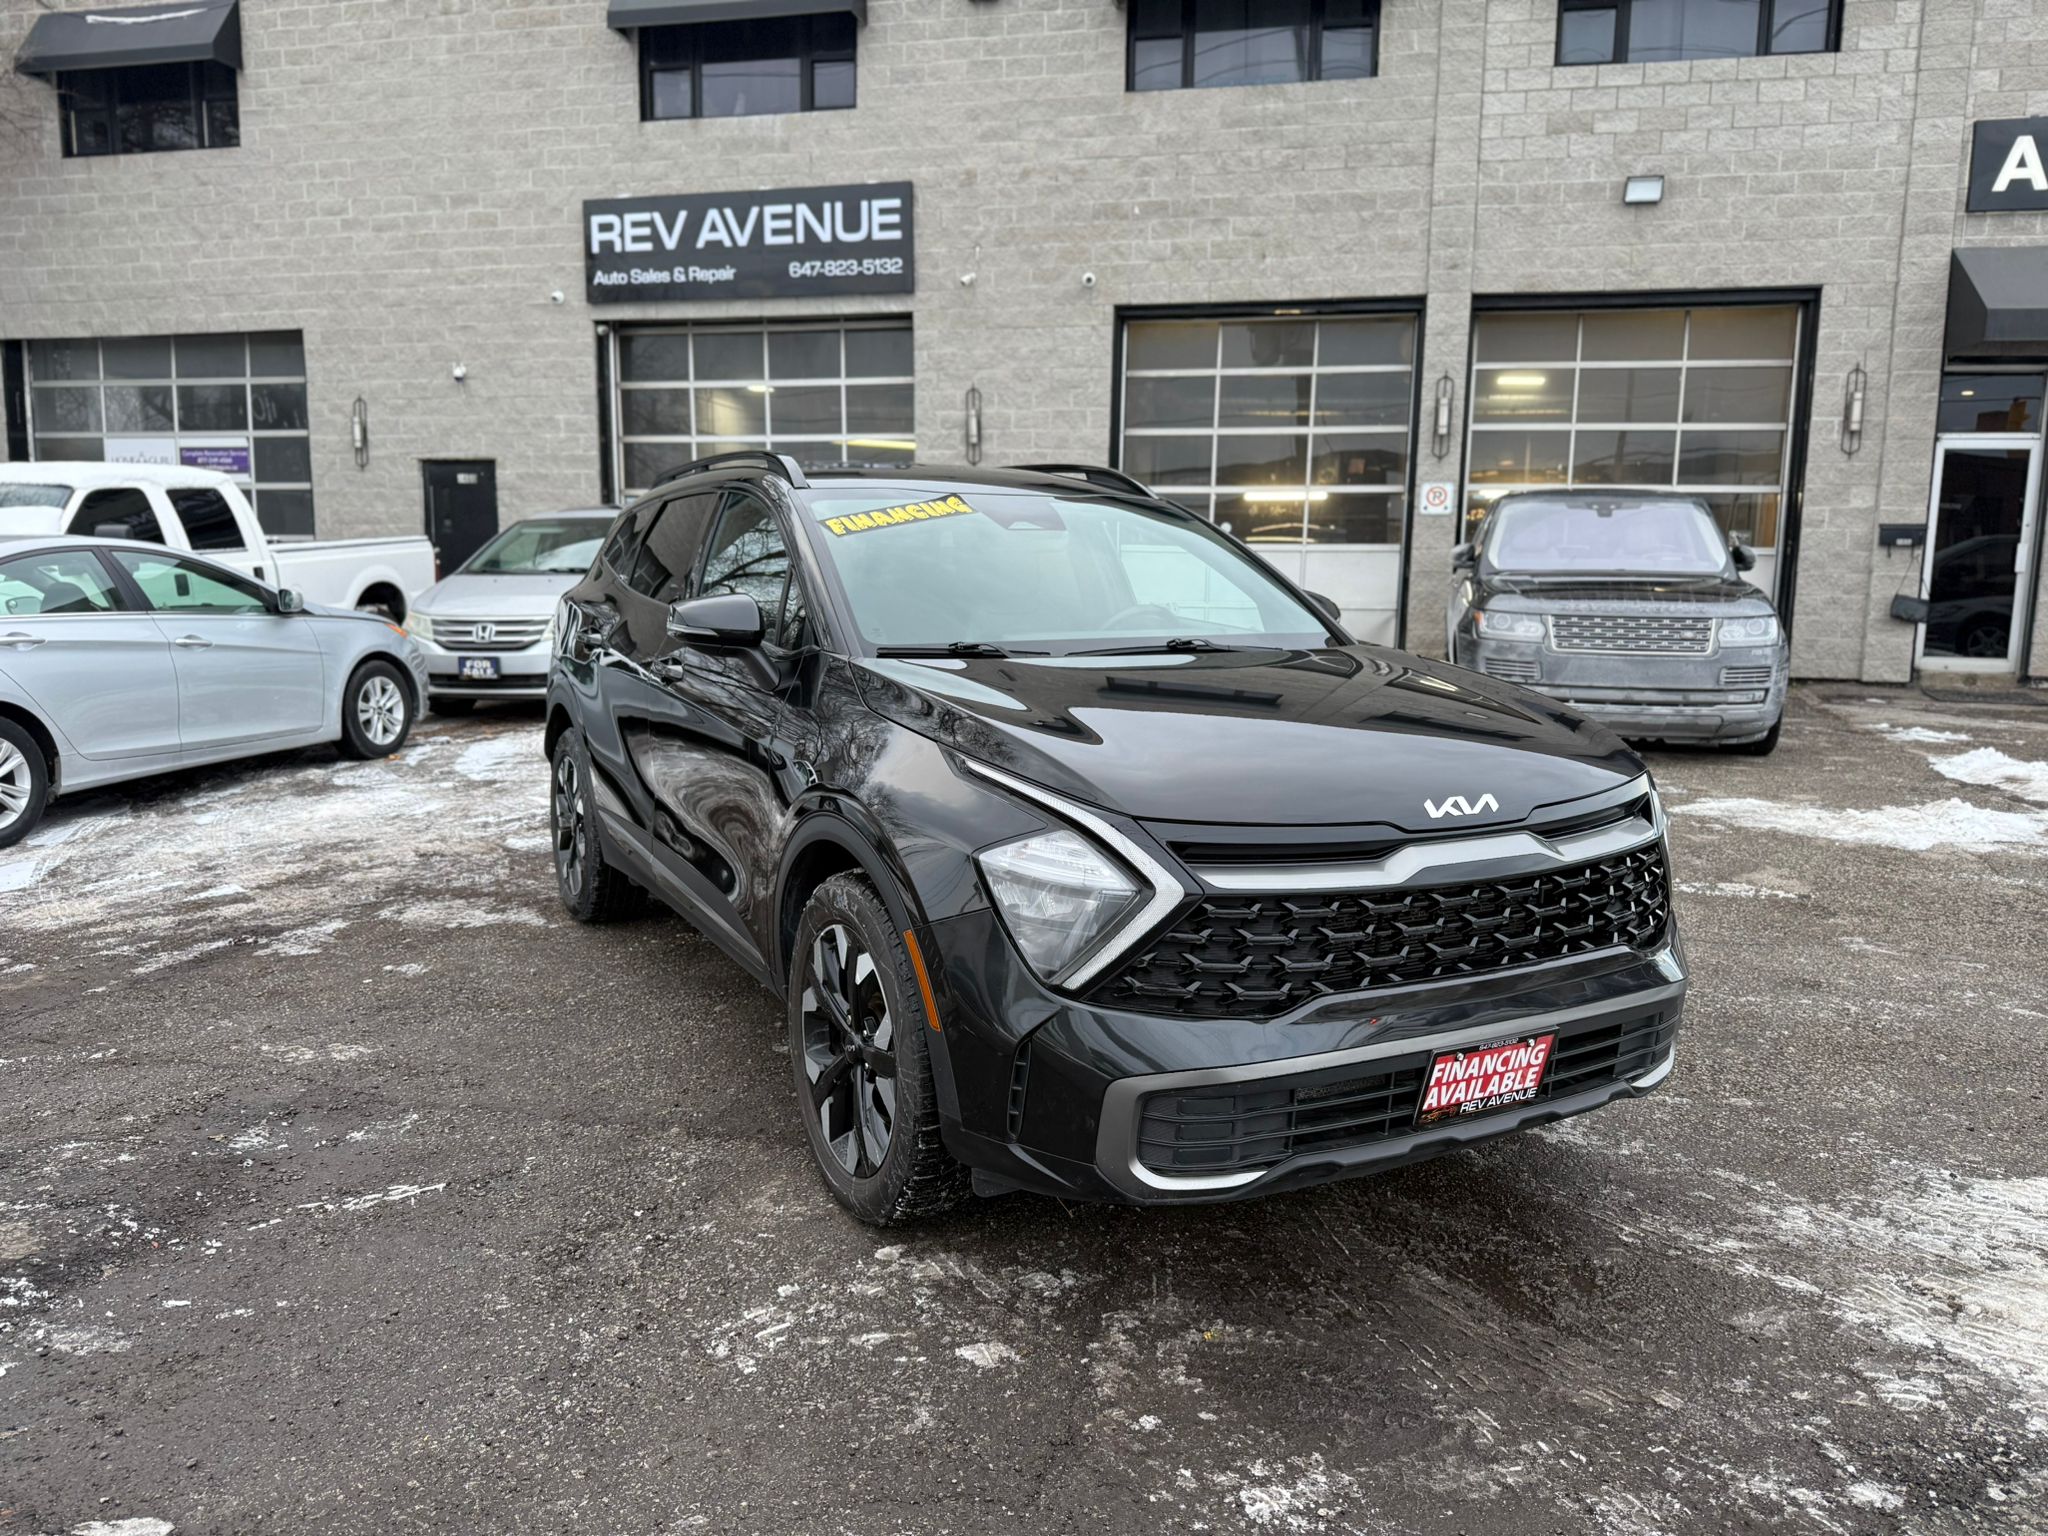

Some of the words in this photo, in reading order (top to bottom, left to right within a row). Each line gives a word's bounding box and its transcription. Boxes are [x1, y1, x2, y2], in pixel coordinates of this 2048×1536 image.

[590, 210, 688, 255] REV
[696, 198, 903, 249] AVENUE
[593, 269, 628, 286] Auto
[630, 268, 671, 284] Sales
[673, 267, 687, 283] &
[688, 265, 737, 285] Repair
[788, 257, 904, 279] 647-823-5132
[825, 496, 973, 536] FINANCING
[463, 667, 495, 677] SALE
[466, 660, 491, 668] FOR
[1423, 793, 1500, 819] KIA
[1430, 1043, 1546, 1087] FINANCING
[1422, 1066, 1540, 1110] AVAILABLE
[1460, 1100, 1487, 1114] REV
[1487, 1086, 1538, 1107] AVENUE
